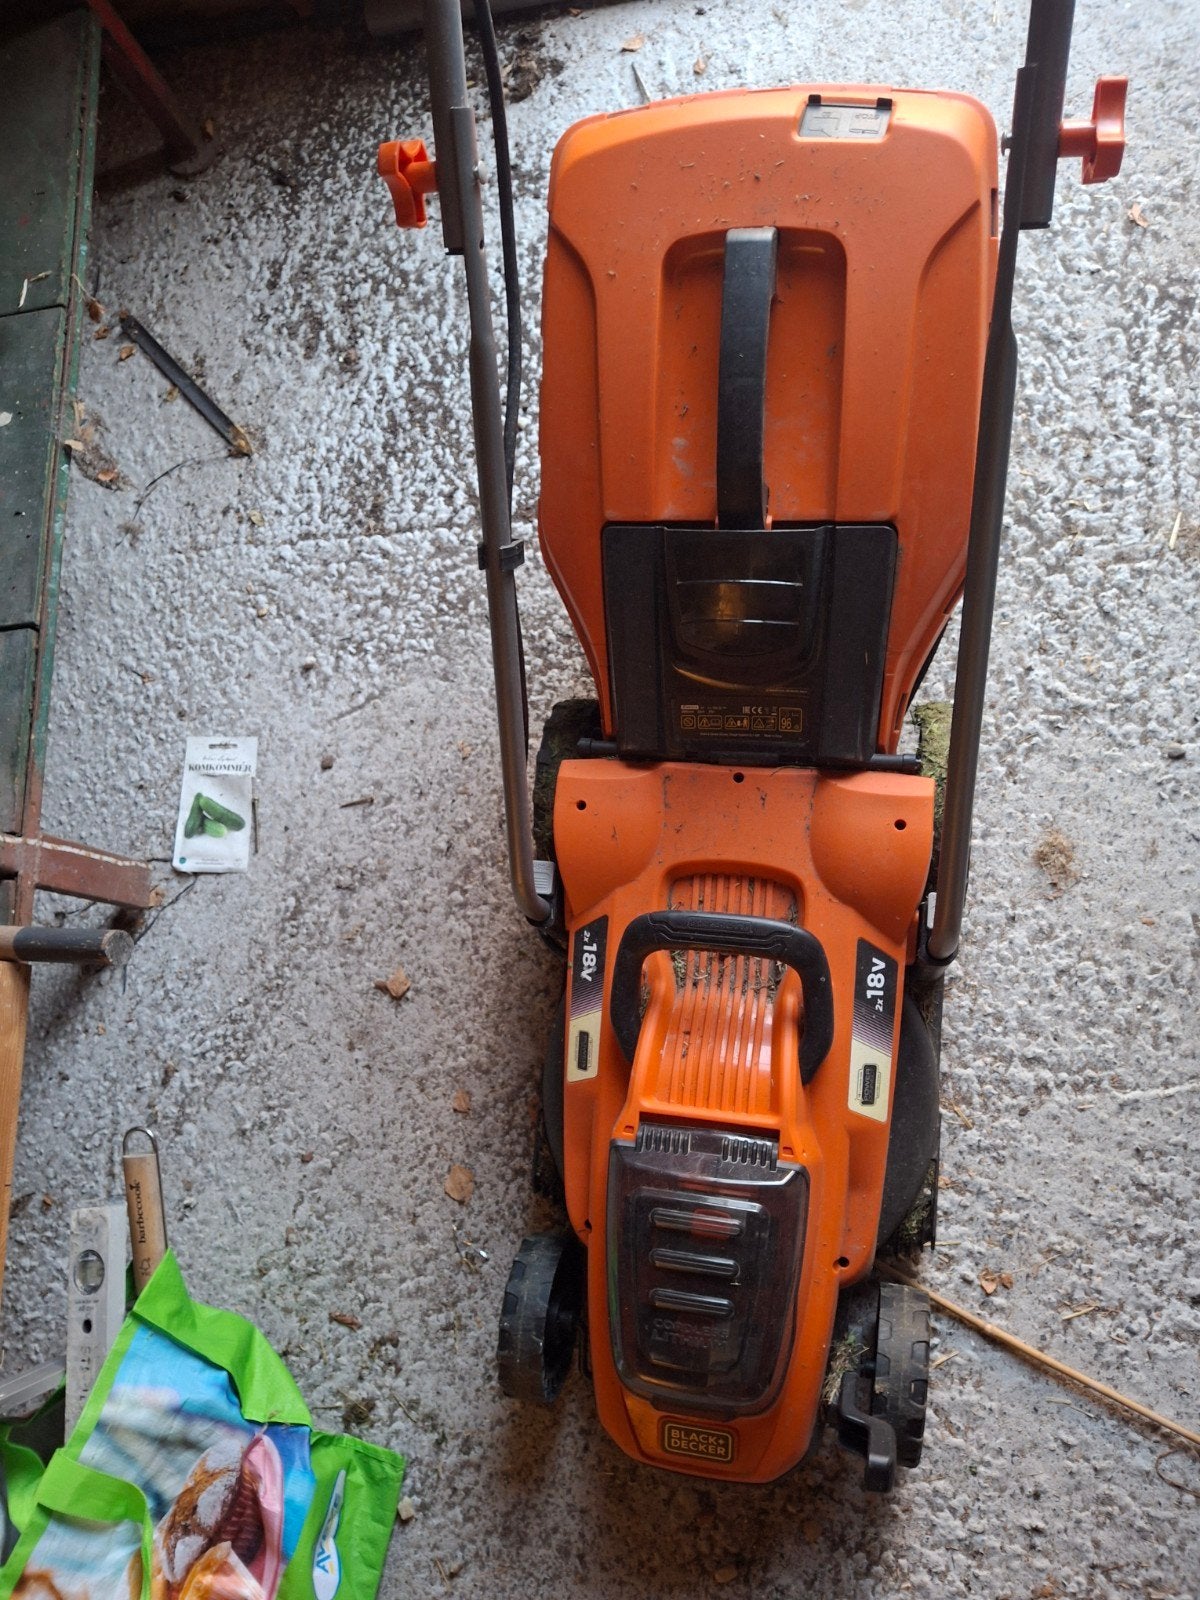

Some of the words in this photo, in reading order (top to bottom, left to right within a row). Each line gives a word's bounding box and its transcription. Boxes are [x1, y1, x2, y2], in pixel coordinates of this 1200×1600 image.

[781, 717, 792, 730] 96
[188, 763, 252, 772] KOMKOMMER
[129, 1182, 146, 1244] barbecook
[671, 1438, 726, 1456] DECKER
